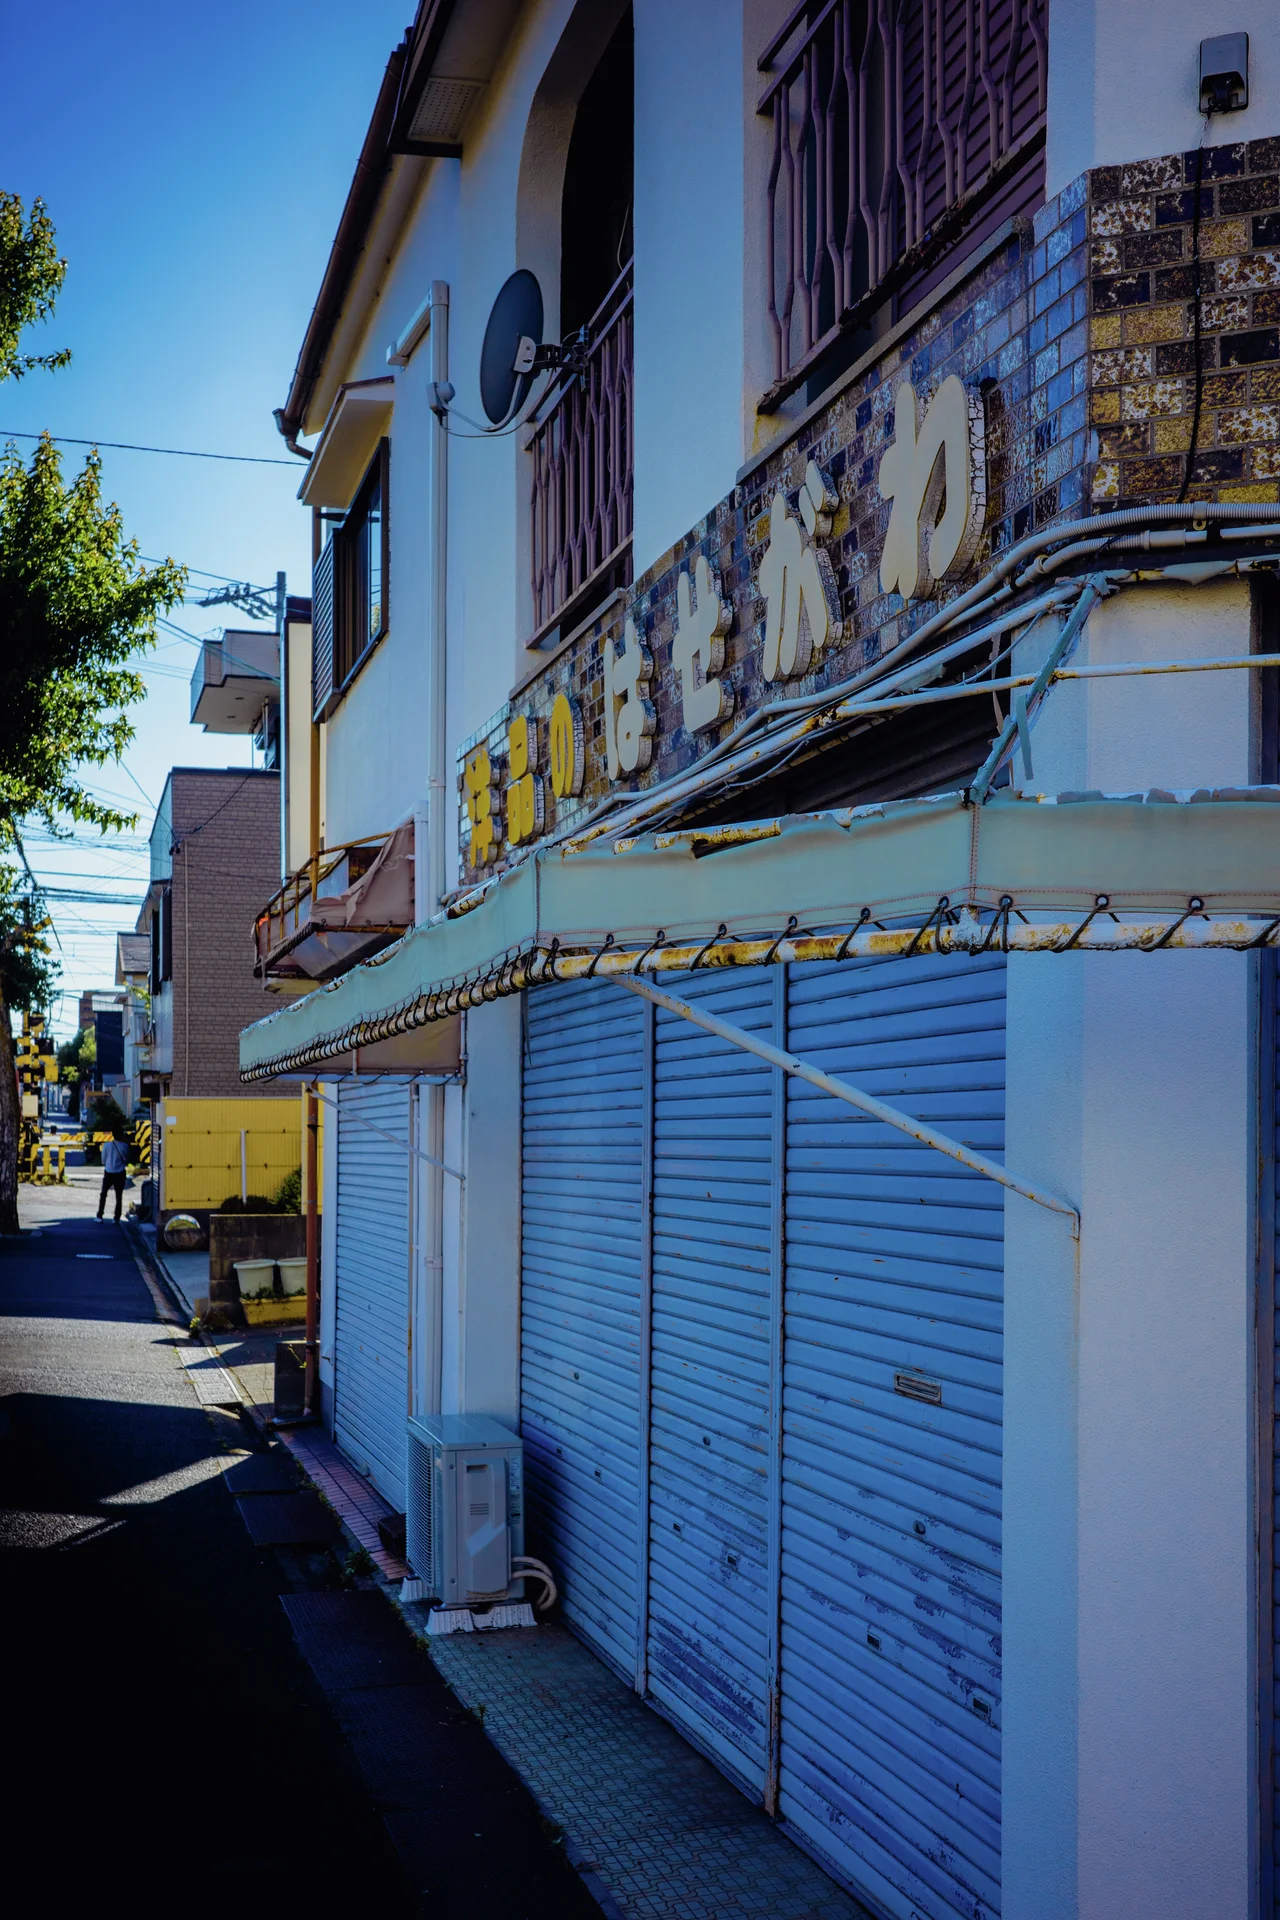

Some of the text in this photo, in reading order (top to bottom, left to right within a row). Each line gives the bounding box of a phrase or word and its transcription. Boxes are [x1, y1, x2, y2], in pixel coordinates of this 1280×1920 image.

[464, 373, 985, 868] 洋品のはせがわ
